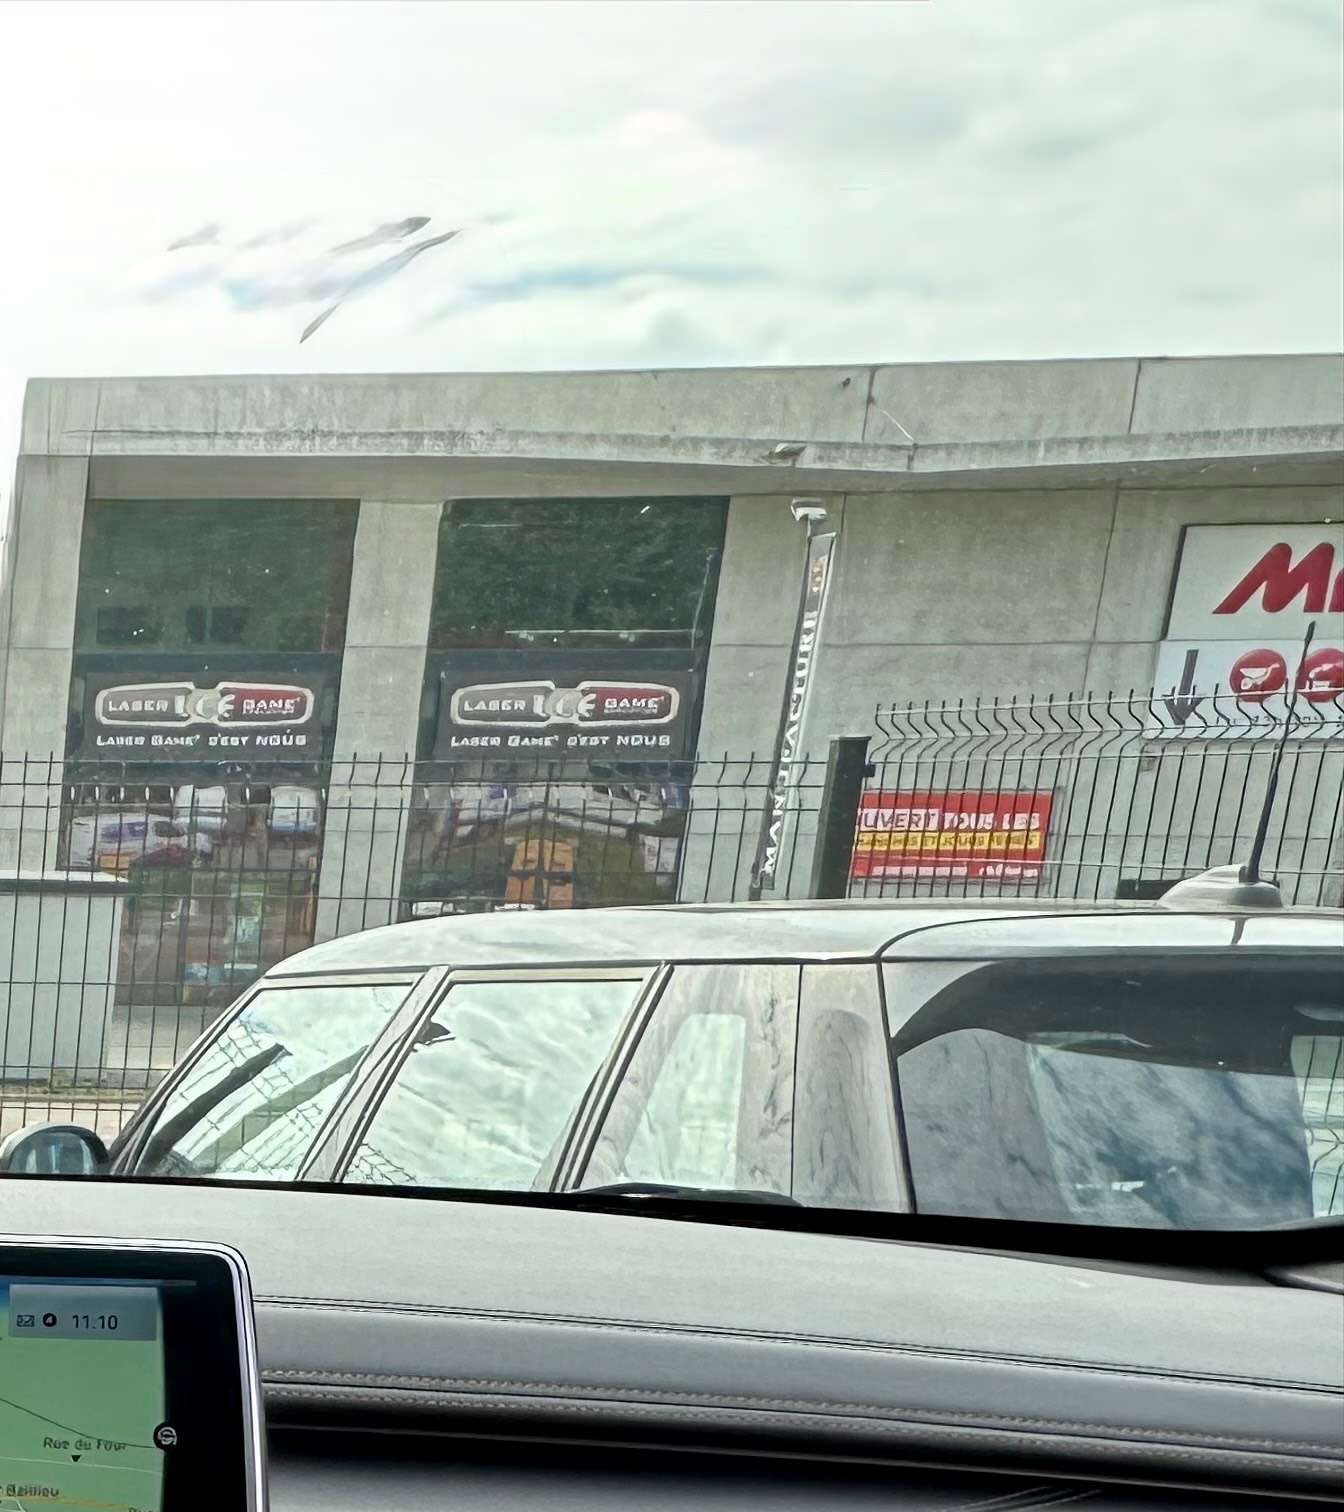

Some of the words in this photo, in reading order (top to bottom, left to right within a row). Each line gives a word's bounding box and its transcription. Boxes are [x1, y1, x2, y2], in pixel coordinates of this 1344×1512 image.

[1212, 542, 1344, 614] M
[858, 810, 938, 830] UVERT
[43, 1436, 70, 1449] Rue
